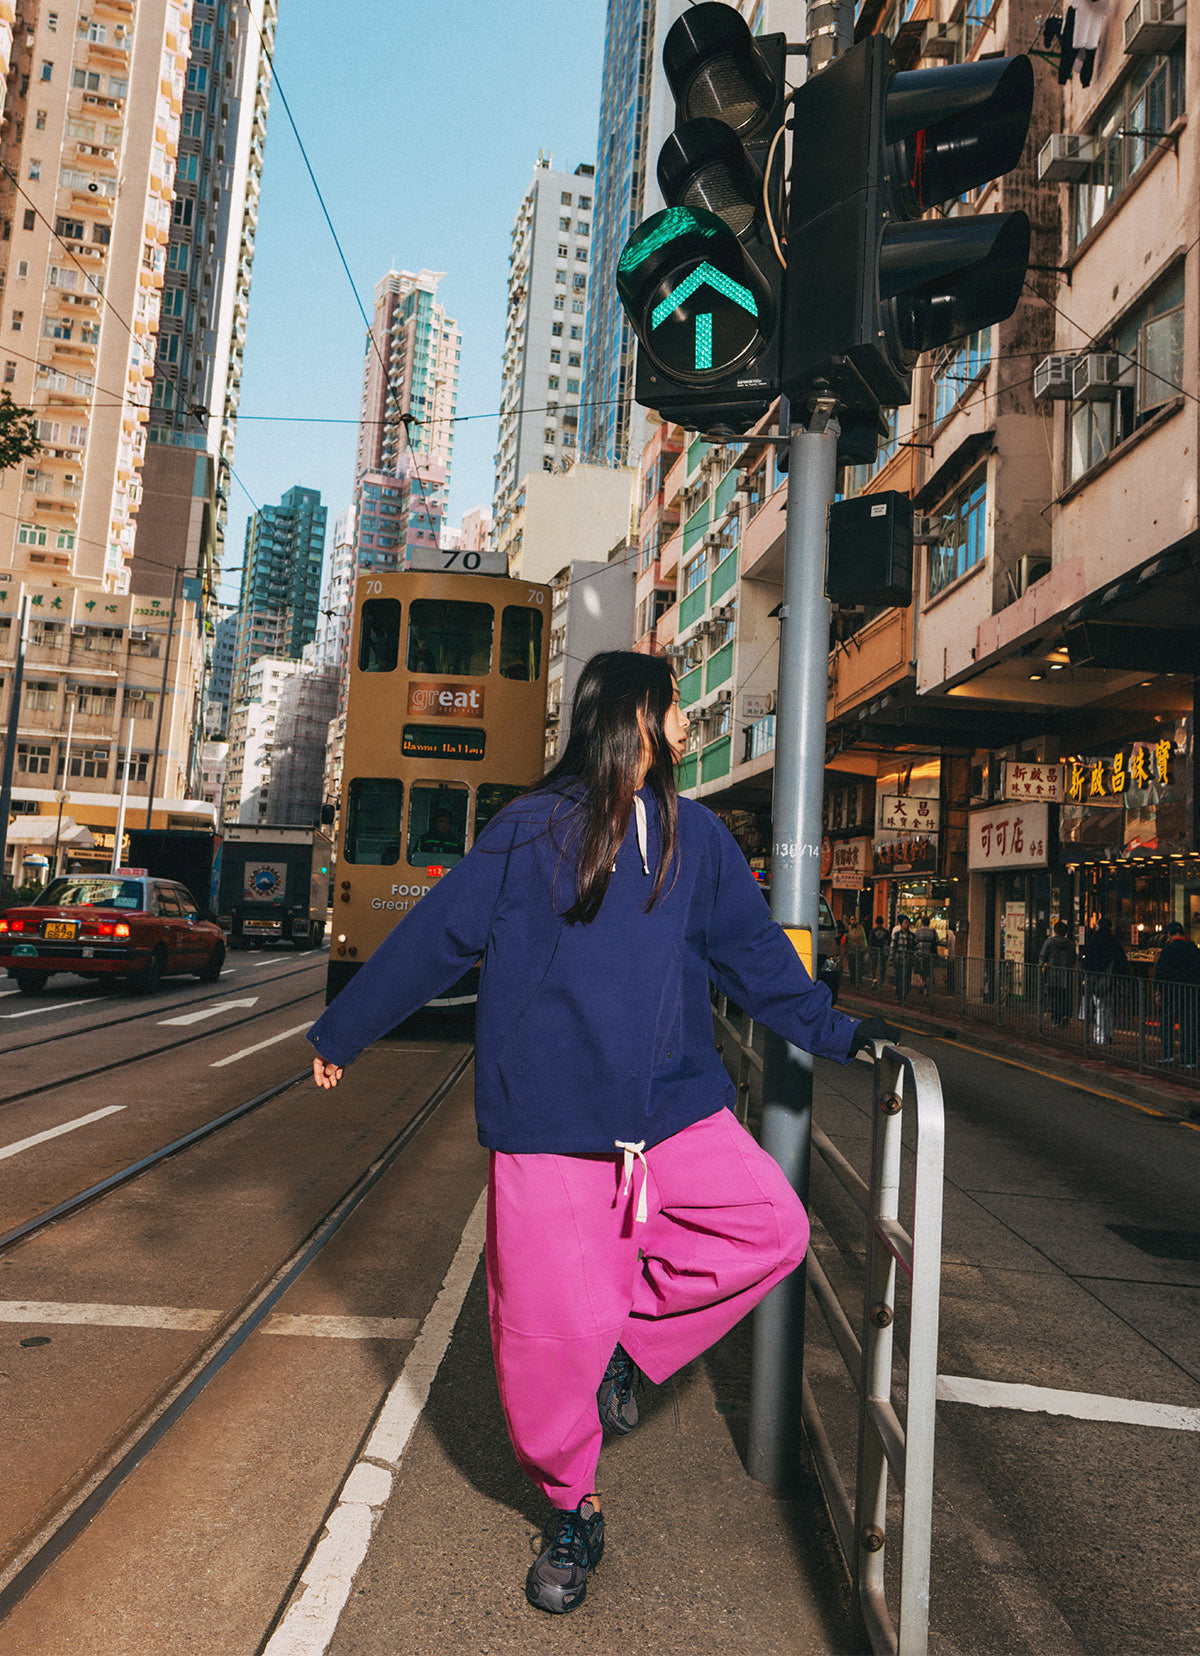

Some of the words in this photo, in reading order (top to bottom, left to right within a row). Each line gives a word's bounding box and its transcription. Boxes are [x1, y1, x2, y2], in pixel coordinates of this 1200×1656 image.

[442, 550, 481, 570] 70
[366, 581, 382, 594] 70
[528, 589, 544, 604] 70
[412, 689, 480, 711] great
[894, 800, 930, 817] 大昌
[981, 817, 1024, 858] 可可店
[1029, 840, 1043, 857] 分店
[775, 843, 820, 858] 138/14
[391, 884, 430, 897] FOOD
[371, 897, 409, 910] Great
